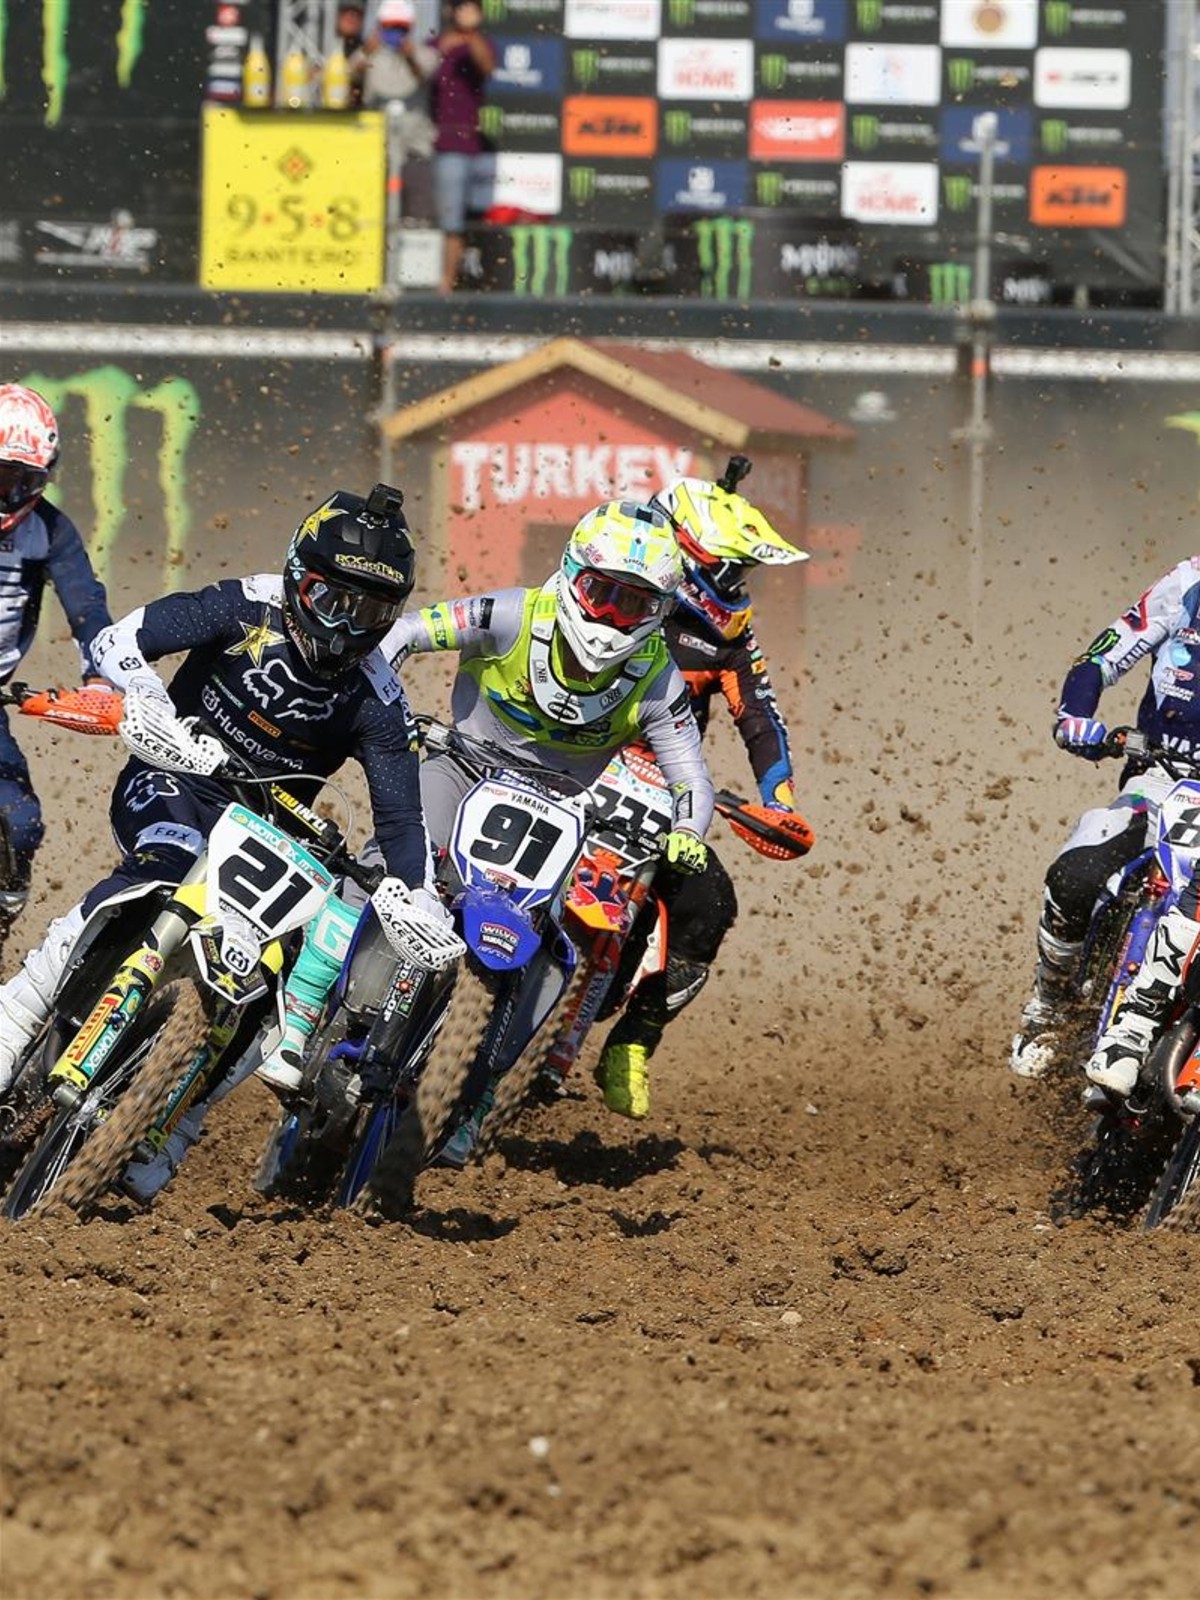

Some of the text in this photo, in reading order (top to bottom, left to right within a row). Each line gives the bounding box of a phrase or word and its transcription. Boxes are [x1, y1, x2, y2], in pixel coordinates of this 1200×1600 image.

[451, 442, 693, 511] TURKEY
[132, 731, 197, 773] ACERBIS
[510, 792, 551, 817] YAMAHA
[779, 819, 810, 838] KTM
[469, 803, 564, 882] 91
[218, 836, 315, 931] 21
[379, 911, 436, 967] ACERBIS
[487, 1000, 515, 1070] DUNLOP
